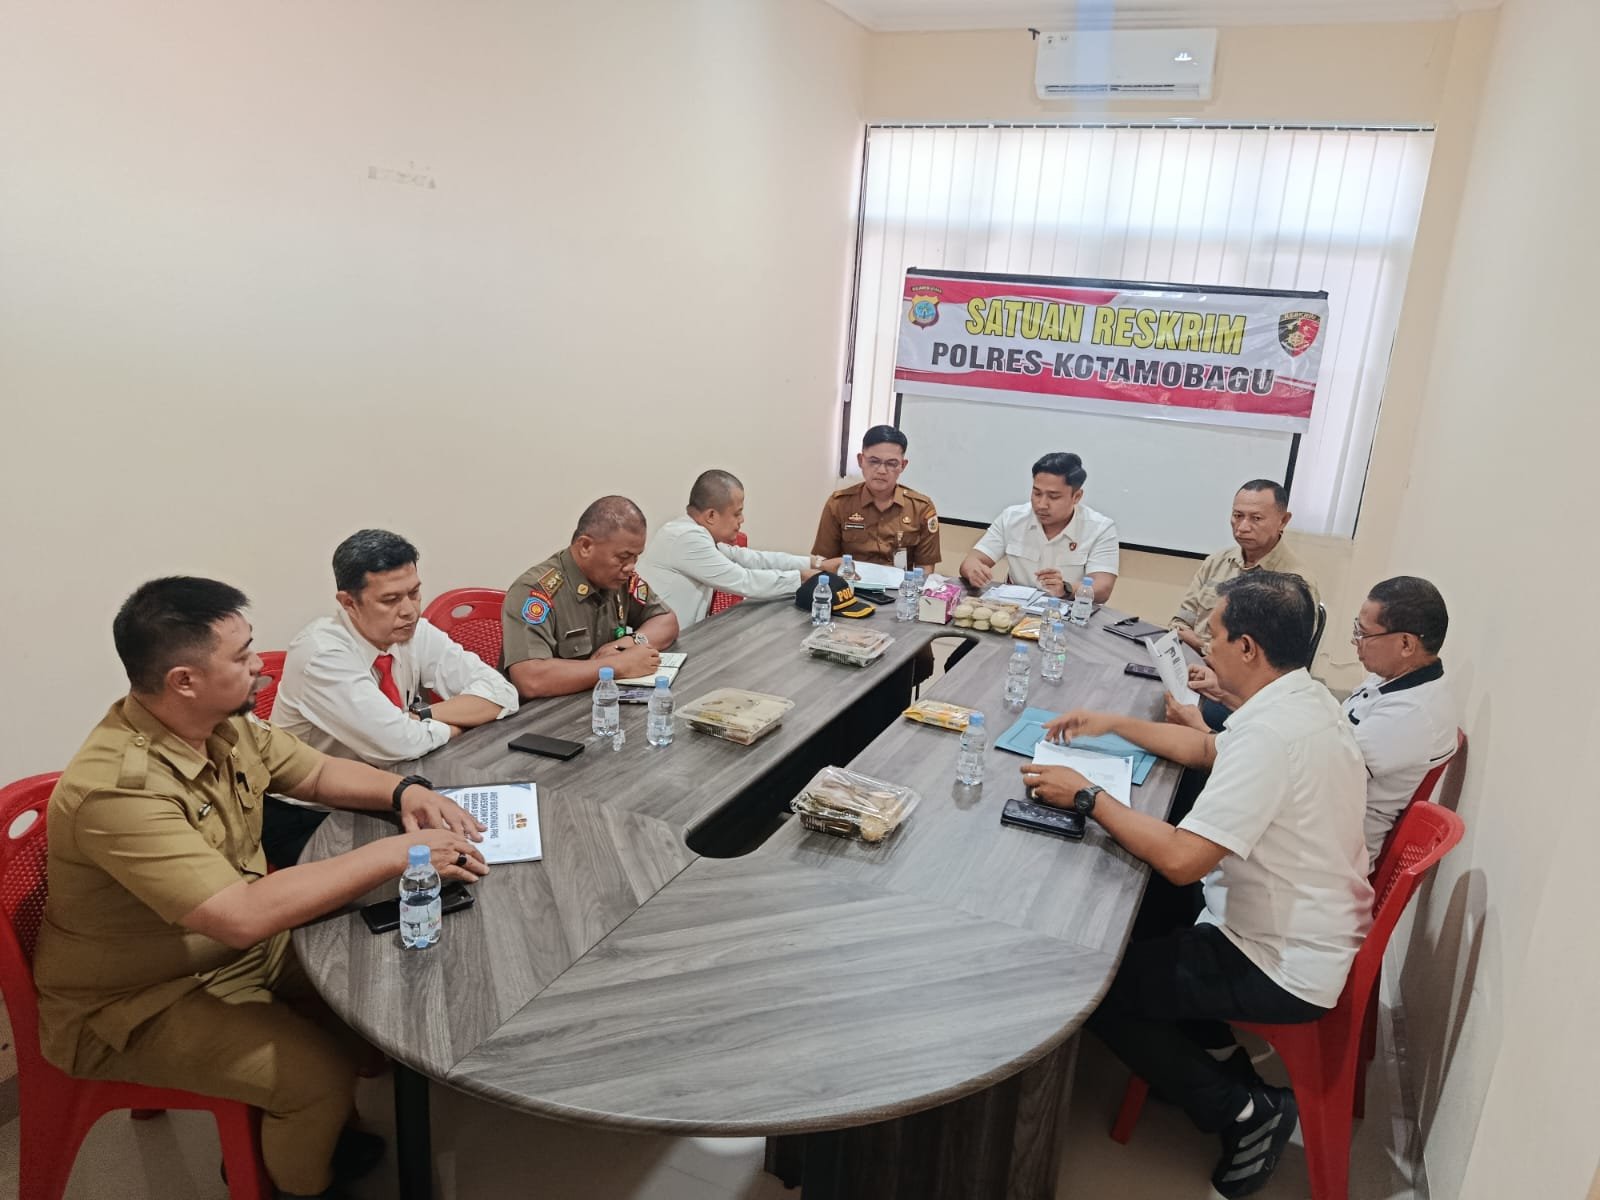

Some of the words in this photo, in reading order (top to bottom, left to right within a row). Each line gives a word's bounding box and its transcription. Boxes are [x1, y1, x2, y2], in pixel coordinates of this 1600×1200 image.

[965, 297, 1084, 343] SATUAN
[1091, 307, 1247, 355] RESKRIM
[931, 342, 1043, 376] POLRES
[1052, 352, 1275, 396] KOTAMOBAGU
